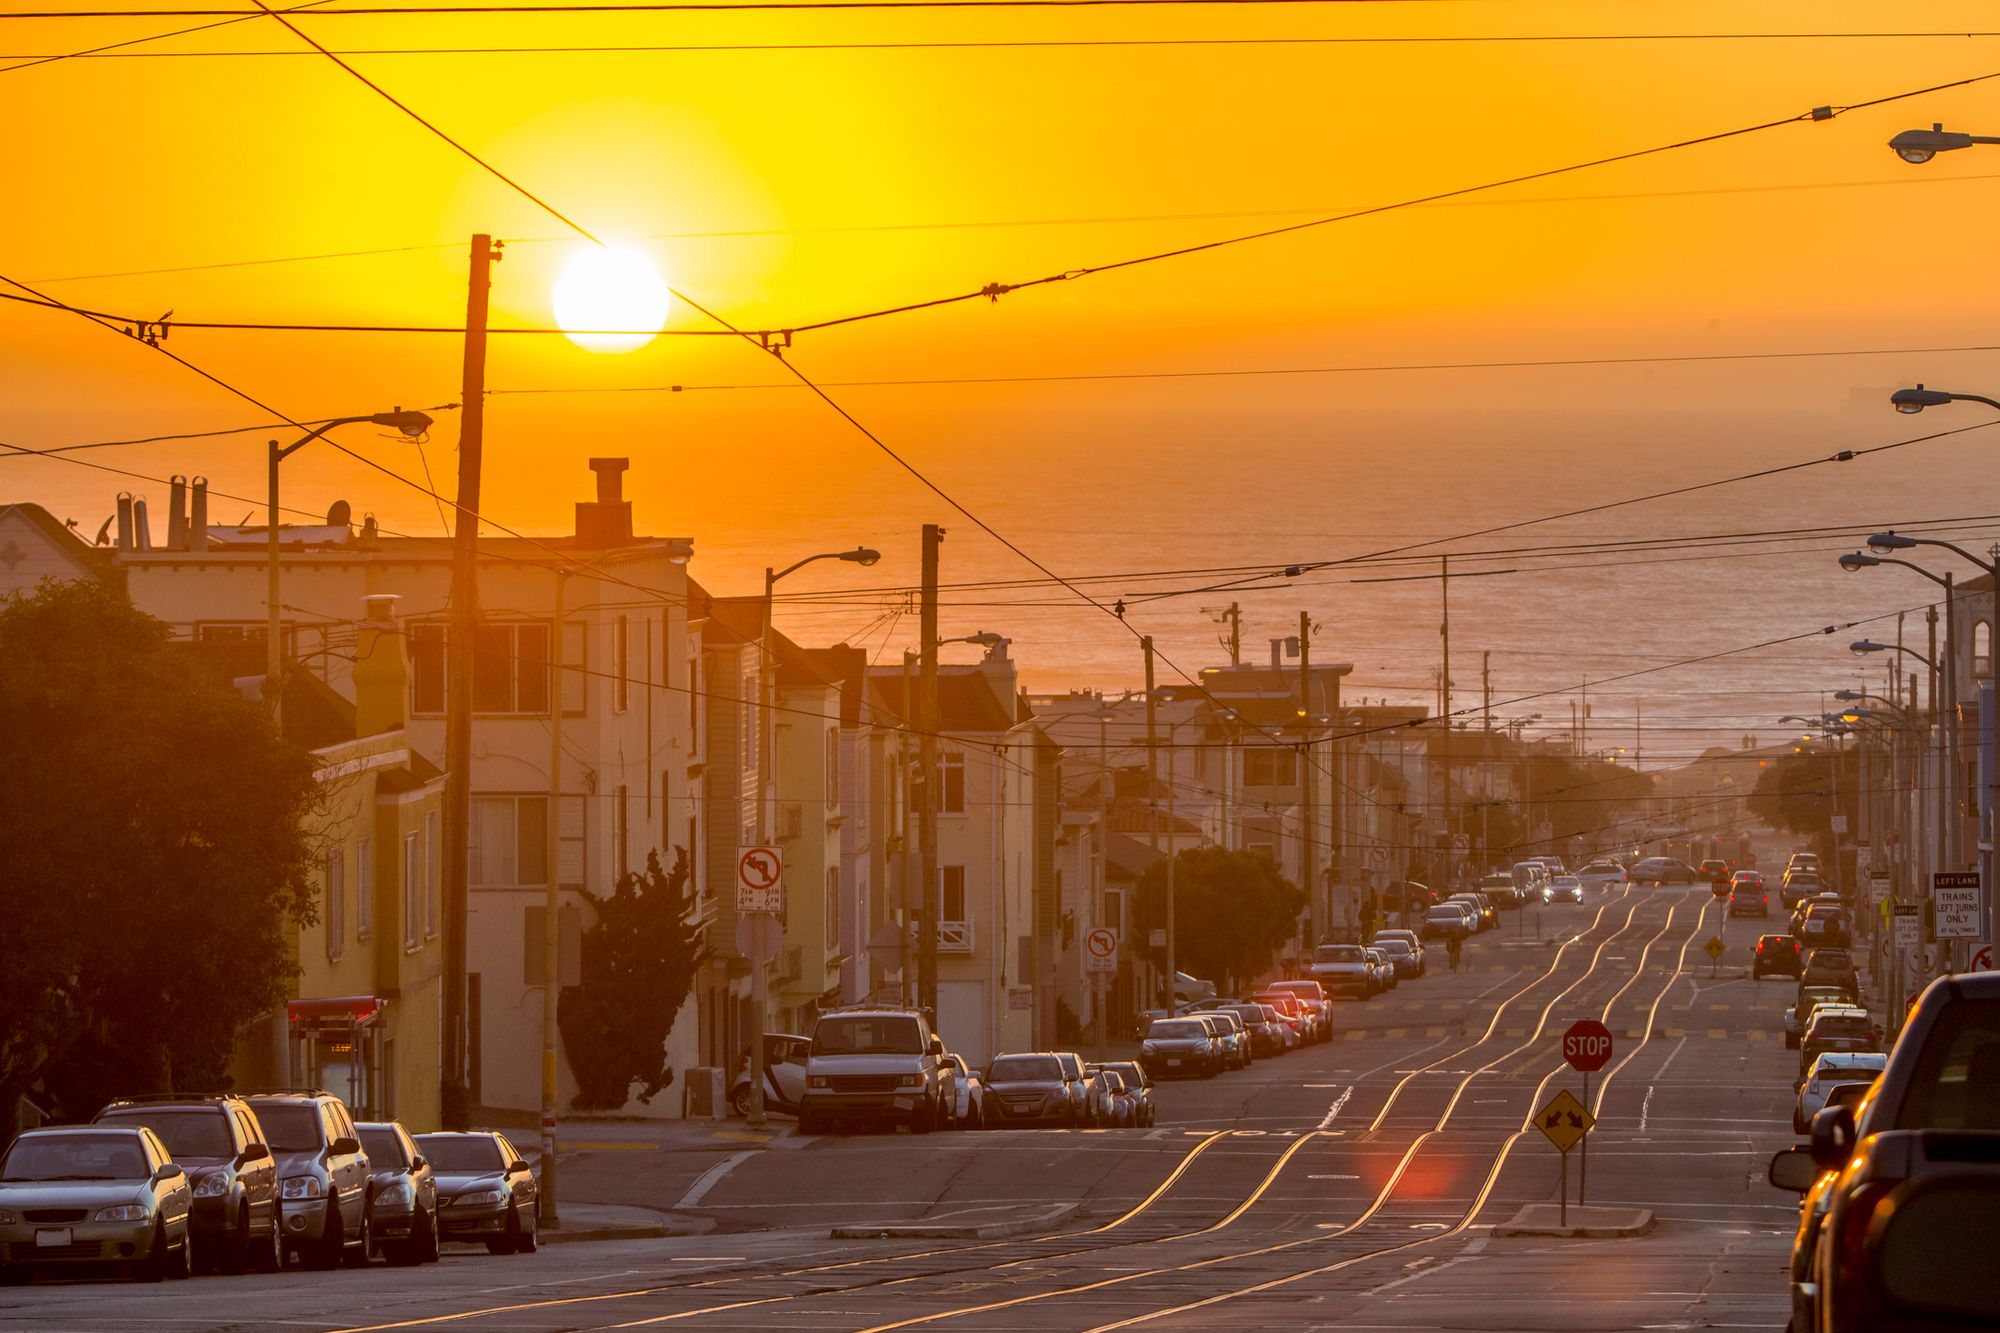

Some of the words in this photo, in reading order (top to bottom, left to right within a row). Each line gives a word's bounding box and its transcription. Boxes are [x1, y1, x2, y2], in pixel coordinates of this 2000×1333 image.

[1957, 877, 1977, 885] LANE
[740, 888, 753, 896] 7AM
[765, 888, 779, 897] 9AM
[1936, 904, 1953, 912] LEFT
[1956, 904, 1978, 912] TURNS
[1946, 915, 1968, 923] ONLY
[1566, 1036, 1610, 1056] STOP
